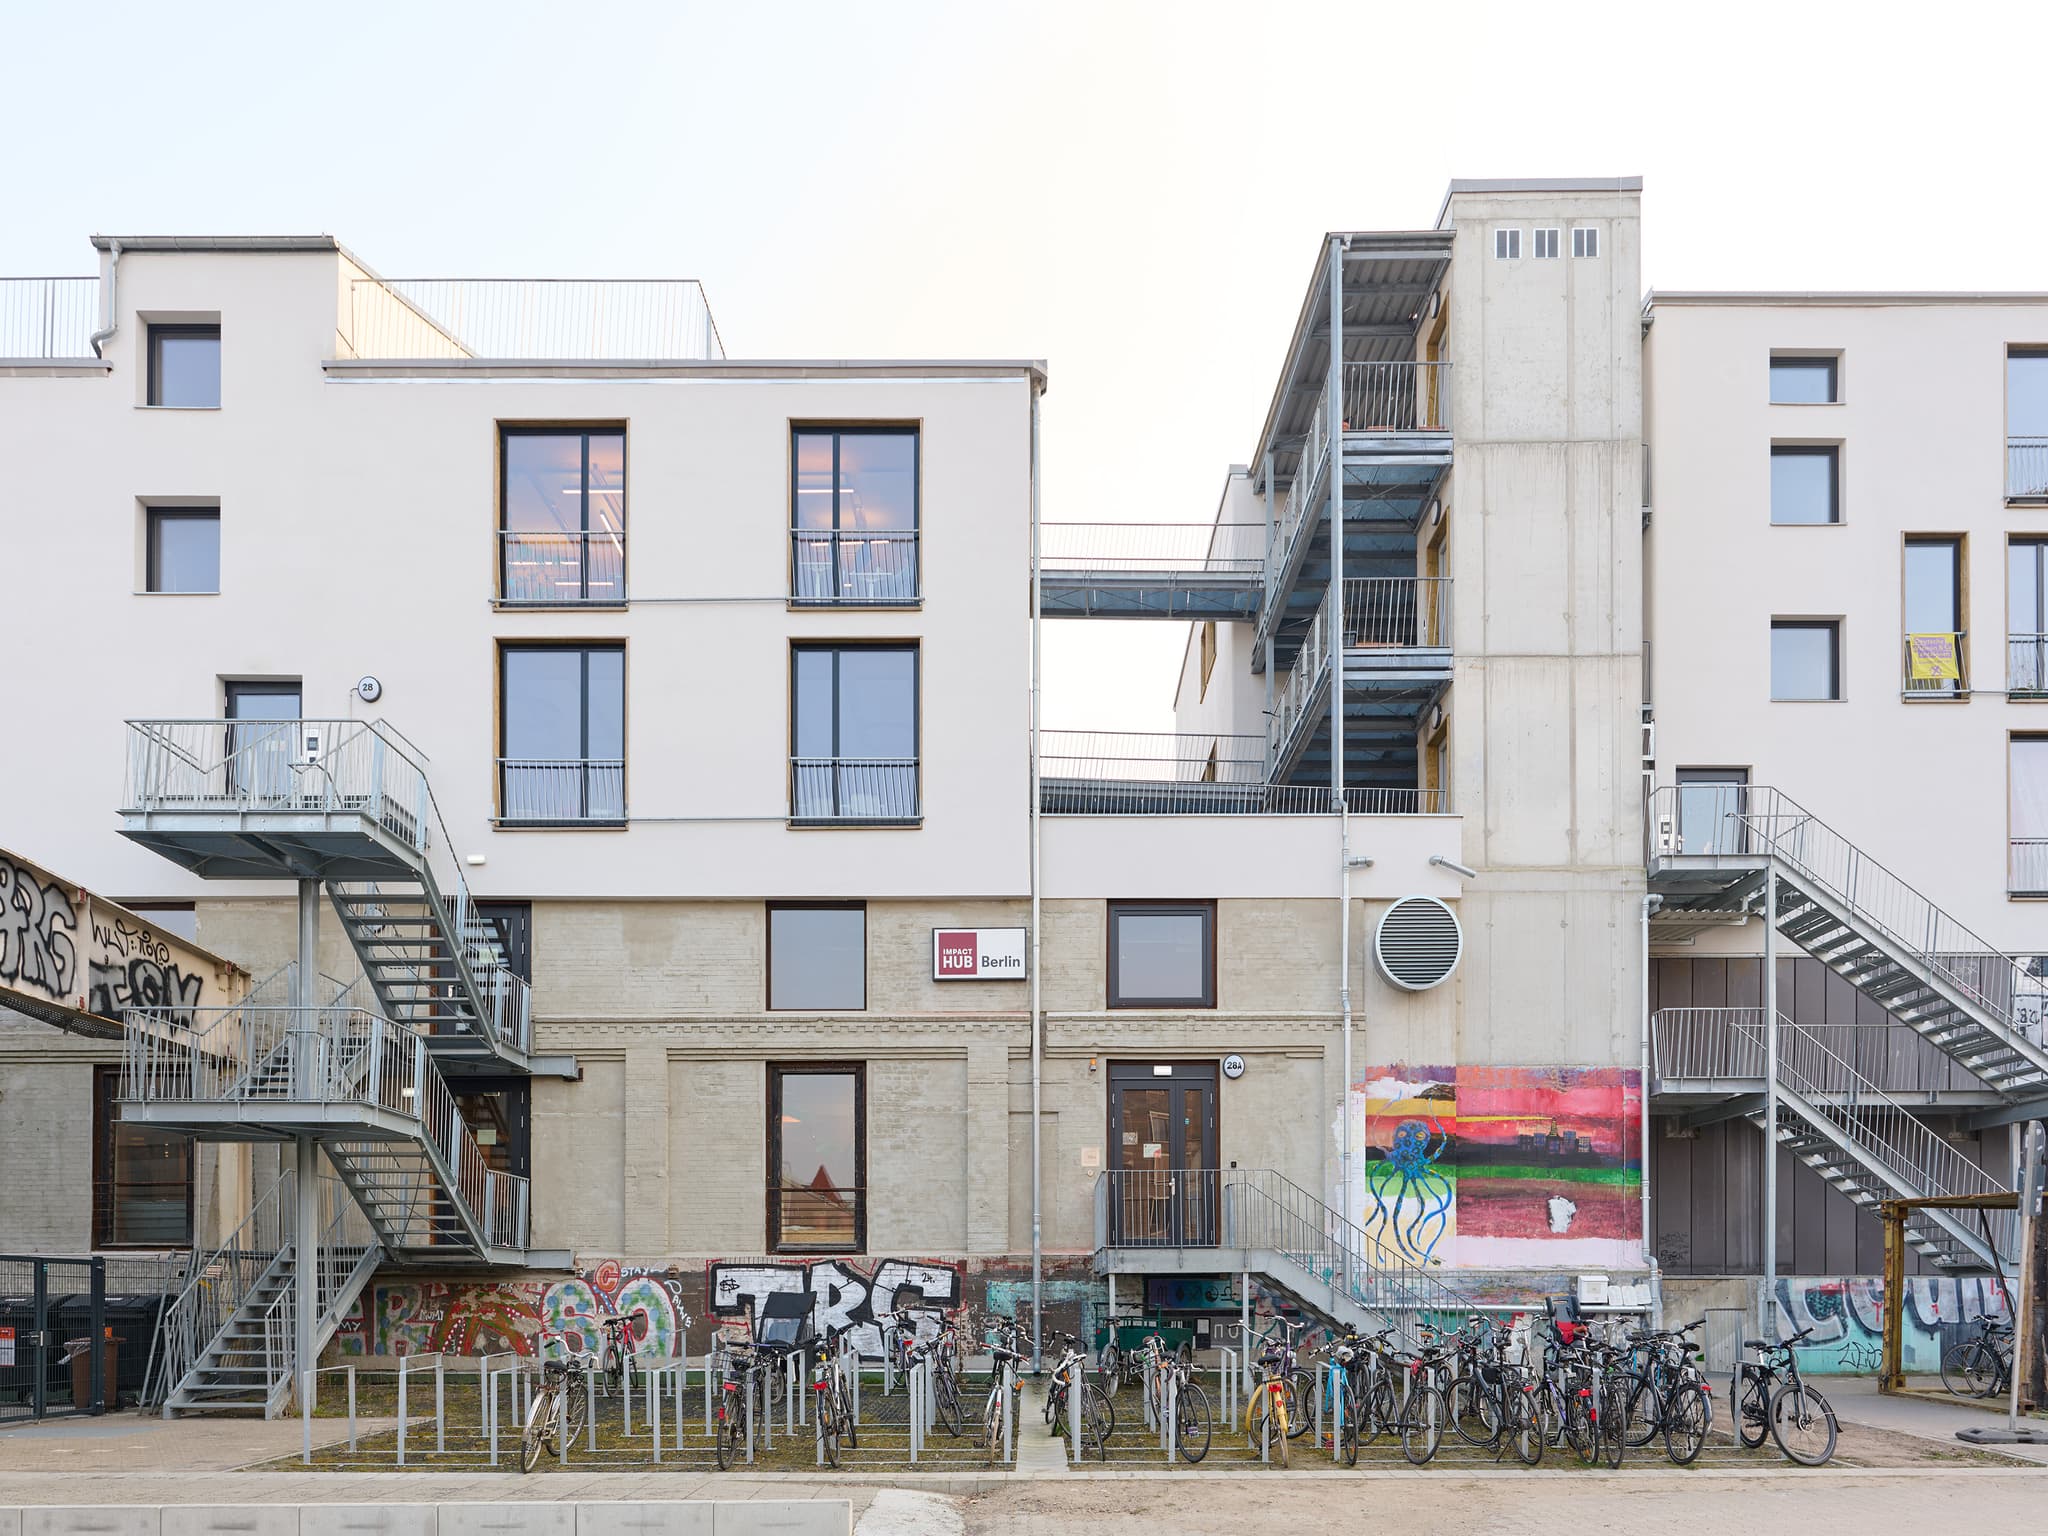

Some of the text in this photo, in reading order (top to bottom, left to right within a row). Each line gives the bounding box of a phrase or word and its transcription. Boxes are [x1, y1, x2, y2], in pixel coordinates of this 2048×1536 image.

[362, 683, 374, 692] 28
[943, 956, 1021, 969] HUB Berlin
[1227, 1061, 1242, 1070] 28A
[621, 1266, 649, 1277] STAY
